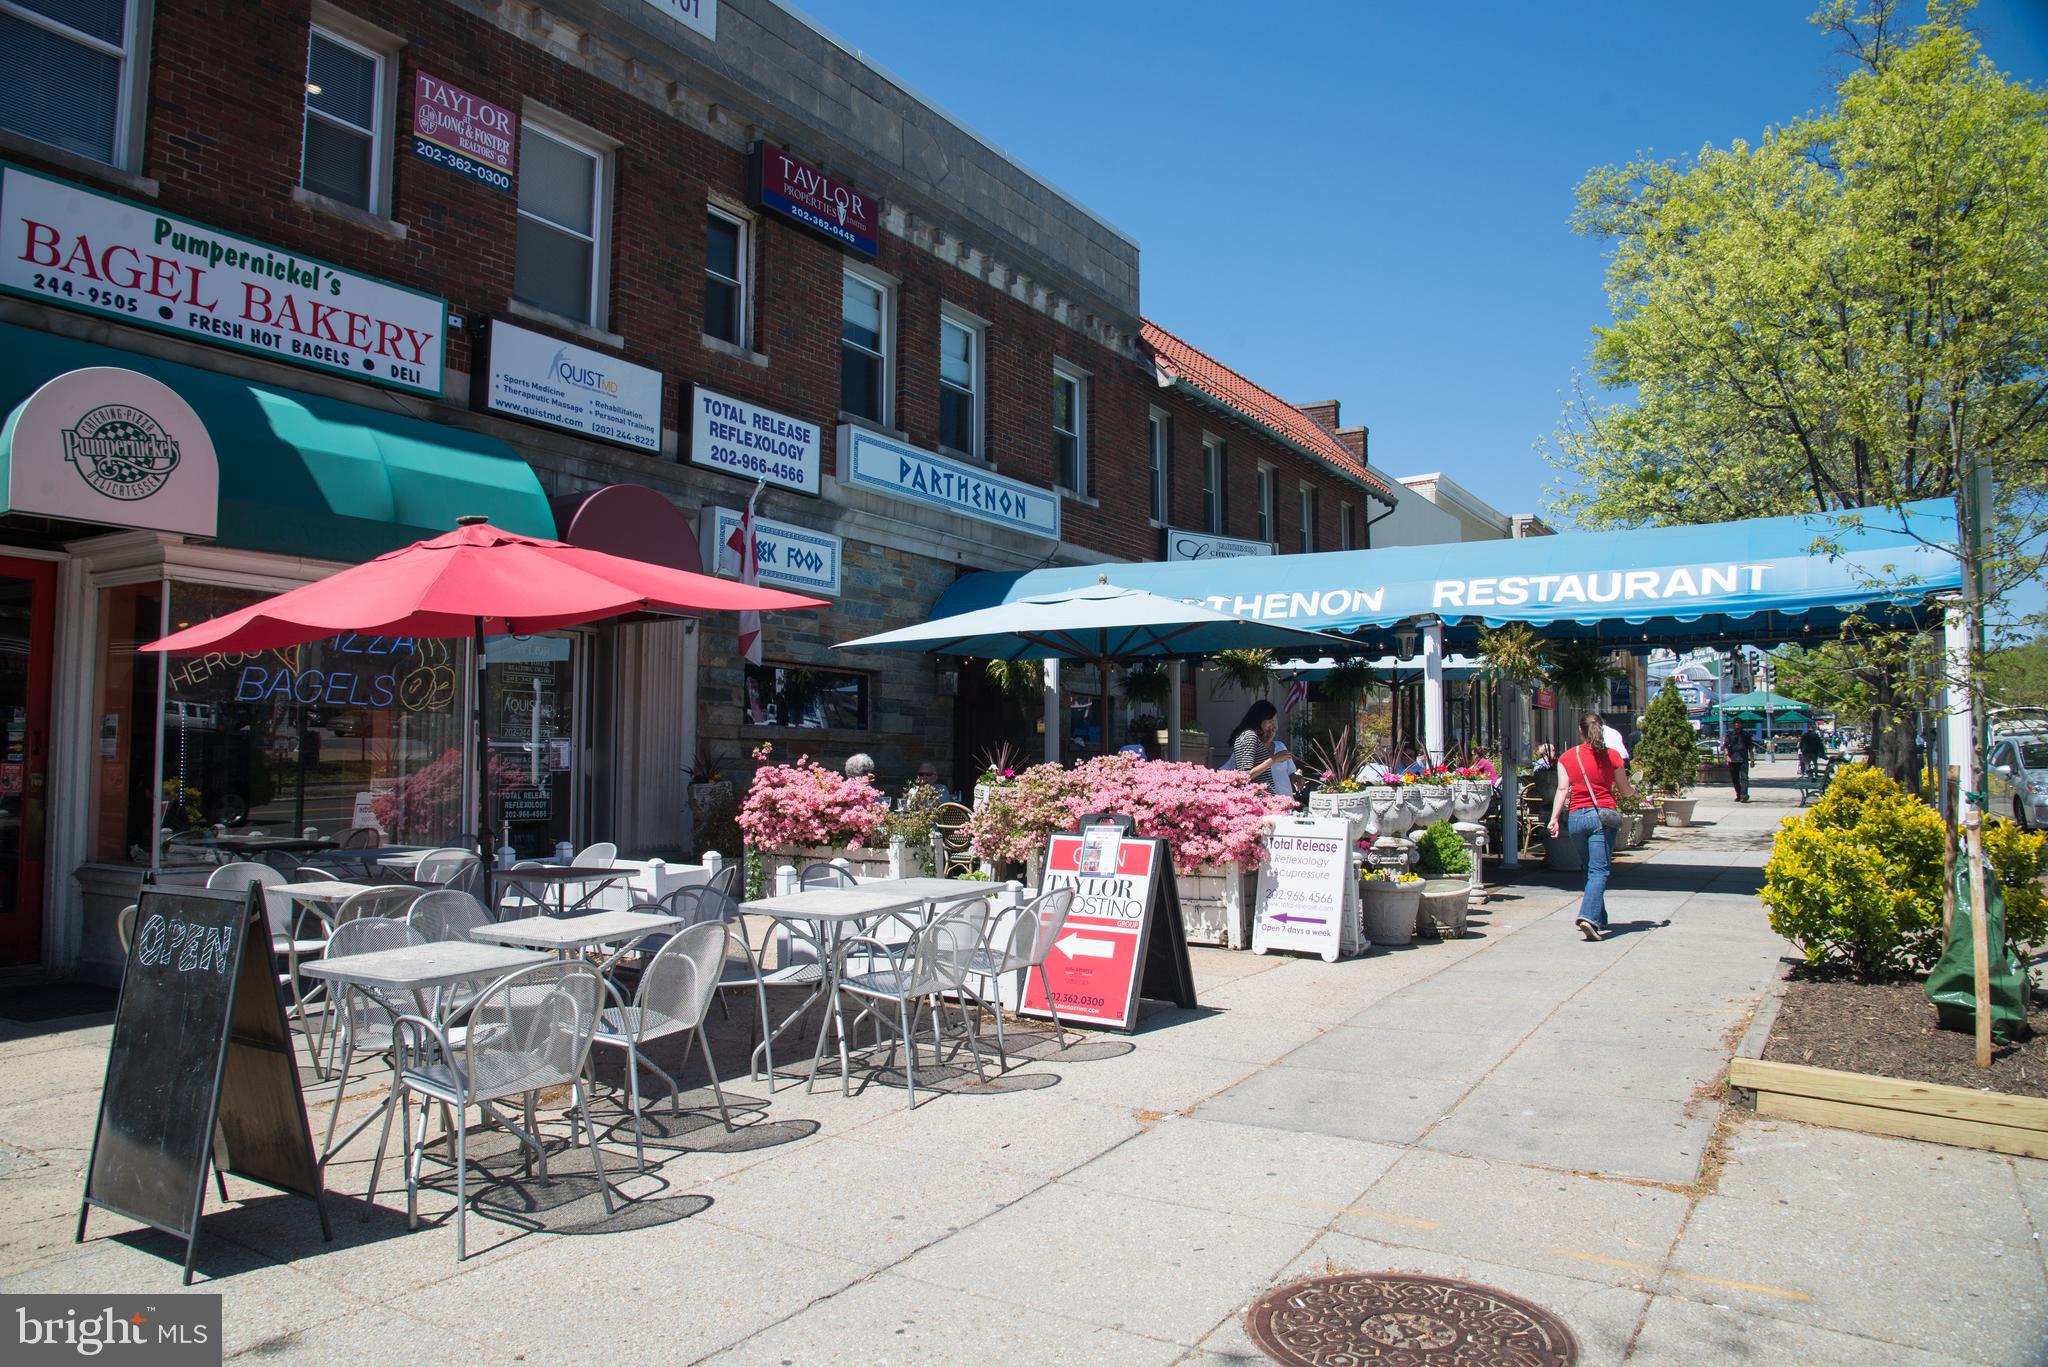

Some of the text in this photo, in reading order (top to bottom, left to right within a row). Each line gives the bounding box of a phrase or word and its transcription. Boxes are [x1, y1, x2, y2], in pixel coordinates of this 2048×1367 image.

[671, 0, 700, 19] 01
[420, 77, 512, 136] TAYLOR
[438, 111, 510, 155] LONG & FOSTER
[417, 141, 509, 188] 202-362-0300
[778, 156, 866, 219] TAYLOR
[783, 183, 837, 218] PROPERTIES
[791, 205, 855, 242] 202-362-0445
[154, 217, 342, 296] Pumpernickel's
[17, 218, 434, 366] BAGEL BAKERY
[33, 273, 138, 312] 244-9505
[189, 312, 350, 366] FRESH HOT BAGELS
[390, 364, 421, 384] DELI
[503, 374, 530, 389] Sports
[531, 380, 565, 398] Medicine
[495, 399, 583, 428] www.quistmd.com
[503, 384, 584, 414] Therapeutic Massage
[595, 400, 643, 420] Rehabilitation
[592, 422, 655, 447] (202) 244-8222
[595, 410, 655, 434] Personal Training
[703, 397, 811, 444] TOTAL RELEASE
[709, 421, 805, 462] REFLEXOLOGY
[710, 445, 804, 484] 202-966-4566
[900, 456, 1026, 520] PARTHENON
[756, 540, 824, 574] EEK FOOD
[1432, 564, 1776, 608] RESTAURANT
[334, 633, 415, 656] IZZA
[169, 651, 263, 691] HERO
[237, 666, 396, 708] BAGELS
[502, 791, 551, 800] TOTAL RELEASE
[504, 801, 547, 809] REFLEXOLOGY
[1269, 838, 1338, 853] Total Release
[1275, 854, 1330, 868] Reflexology
[1047, 874, 1133, 899] TAYLOR
[1265, 888, 1333, 904] 202.966.4566
[1116, 920, 1140, 929] GROUP
[1261, 924, 1280, 933] Open
[1288, 926, 1304, 935] days
[1313, 929, 1331, 937] week
[139, 914, 232, 974] OPEN
[1045, 992, 1105, 1007] 02.362.0300
